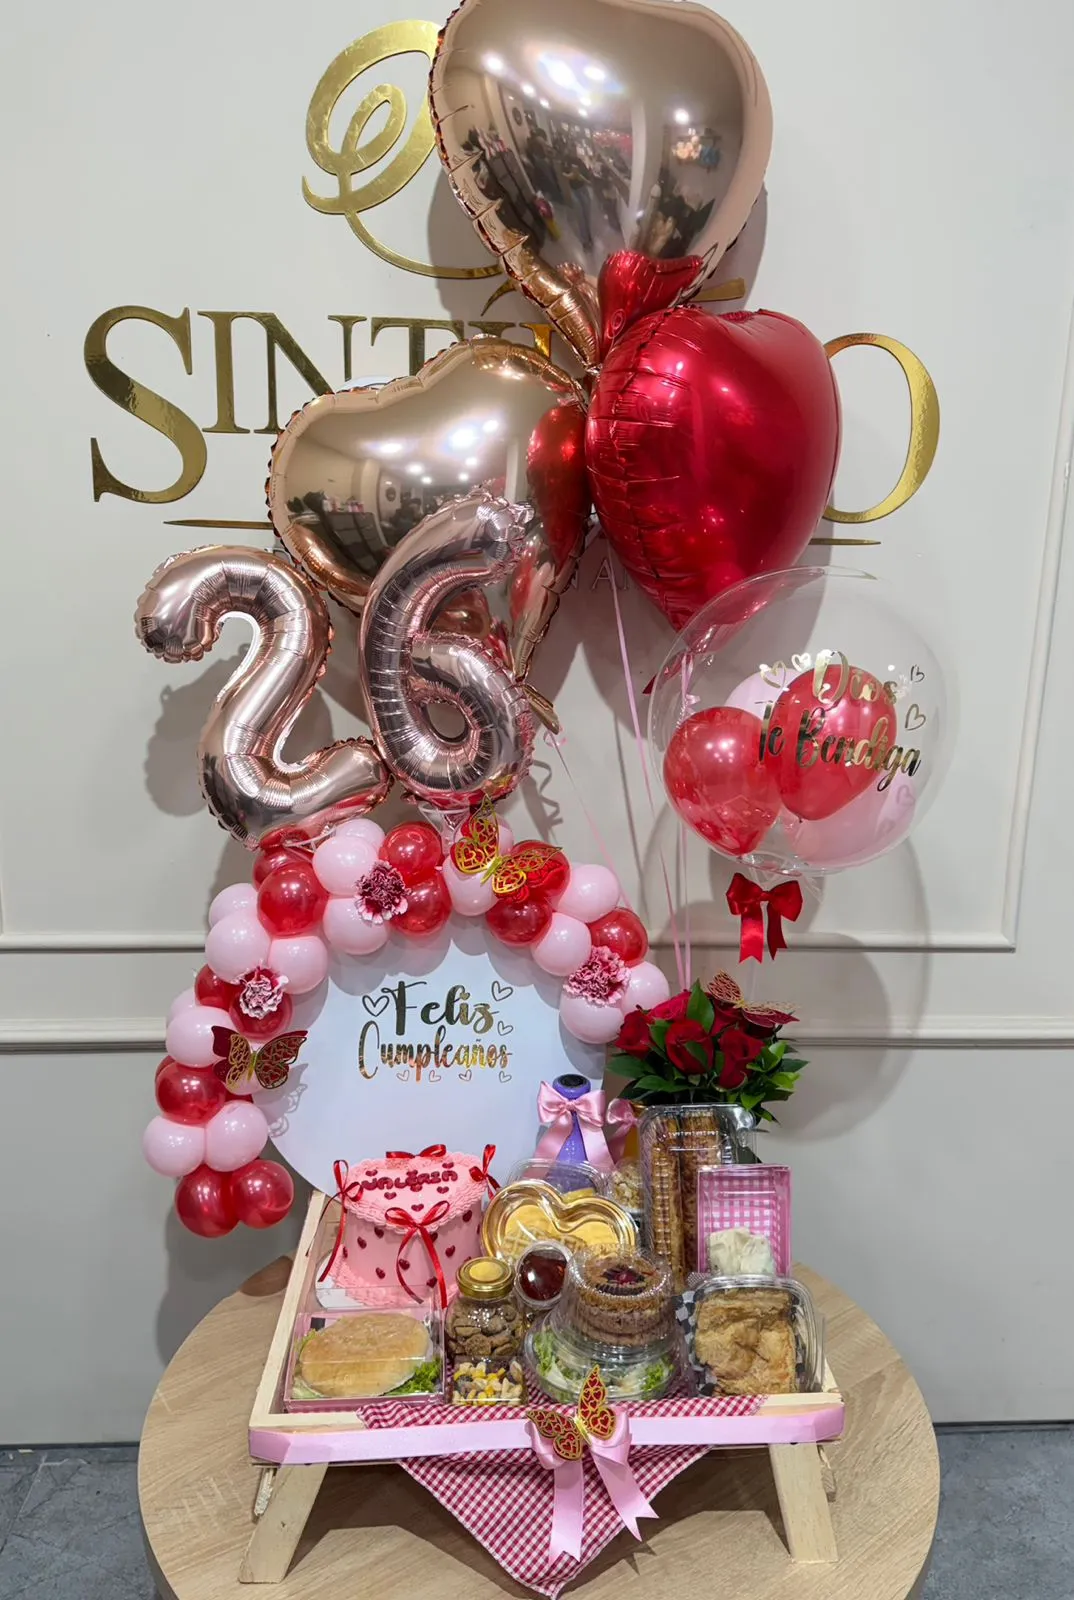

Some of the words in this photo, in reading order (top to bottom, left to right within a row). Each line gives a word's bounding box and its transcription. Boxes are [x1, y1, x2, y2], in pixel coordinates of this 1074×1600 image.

[135, 482, 535, 851] 26
[797, 704, 922, 792] Bendiga
[381, 980, 500, 1036] Feliz
[358, 1020, 513, 1082] Cumpleaños
